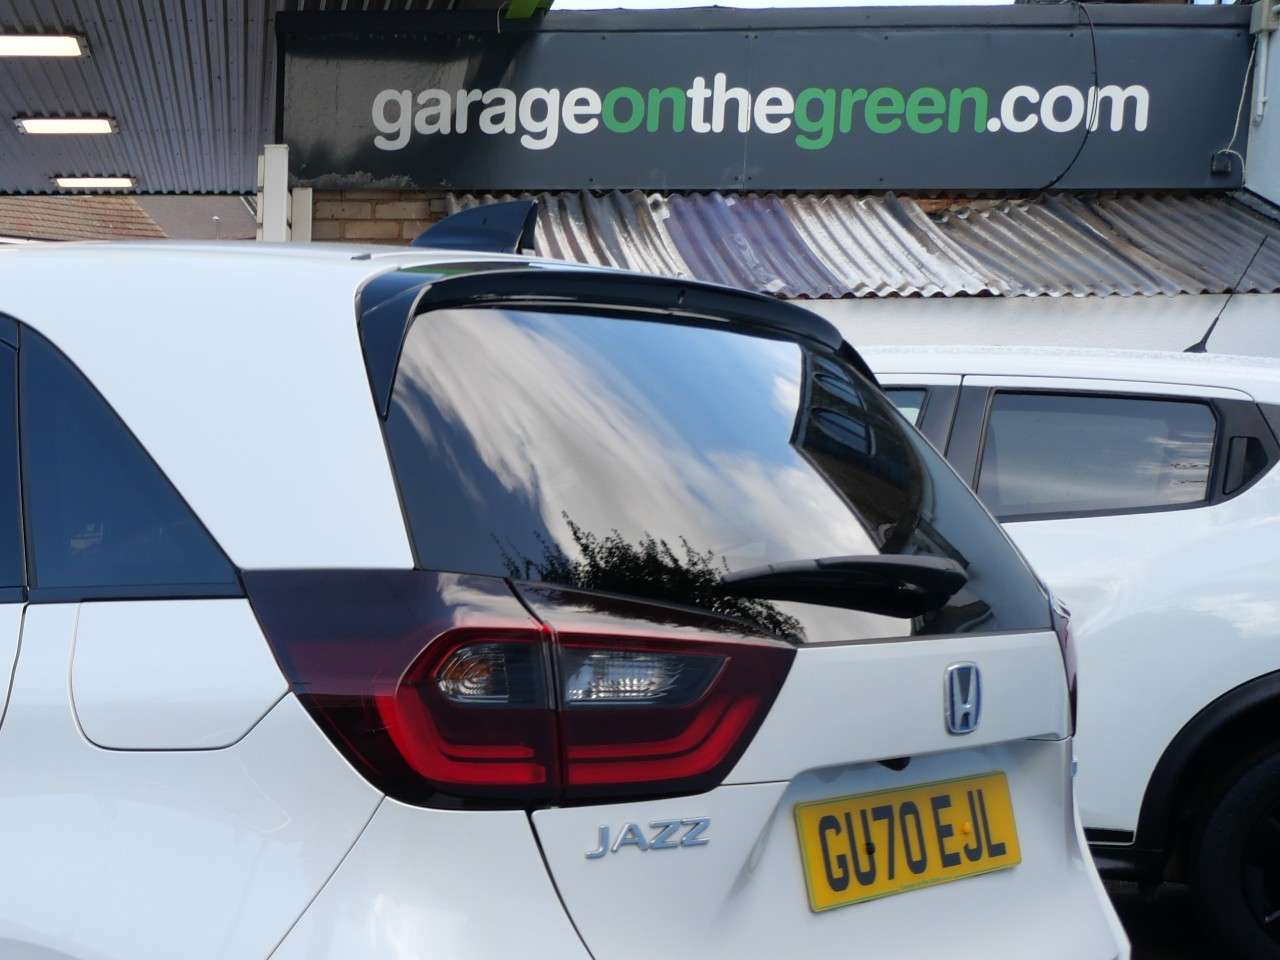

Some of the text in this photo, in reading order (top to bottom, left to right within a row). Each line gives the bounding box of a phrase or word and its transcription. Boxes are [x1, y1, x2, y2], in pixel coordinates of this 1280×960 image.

[372, 72, 1149, 150] garageonthegreen.com
[584, 817, 713, 860] JAZZ
[818, 788, 1007, 892] GU70 EJL
